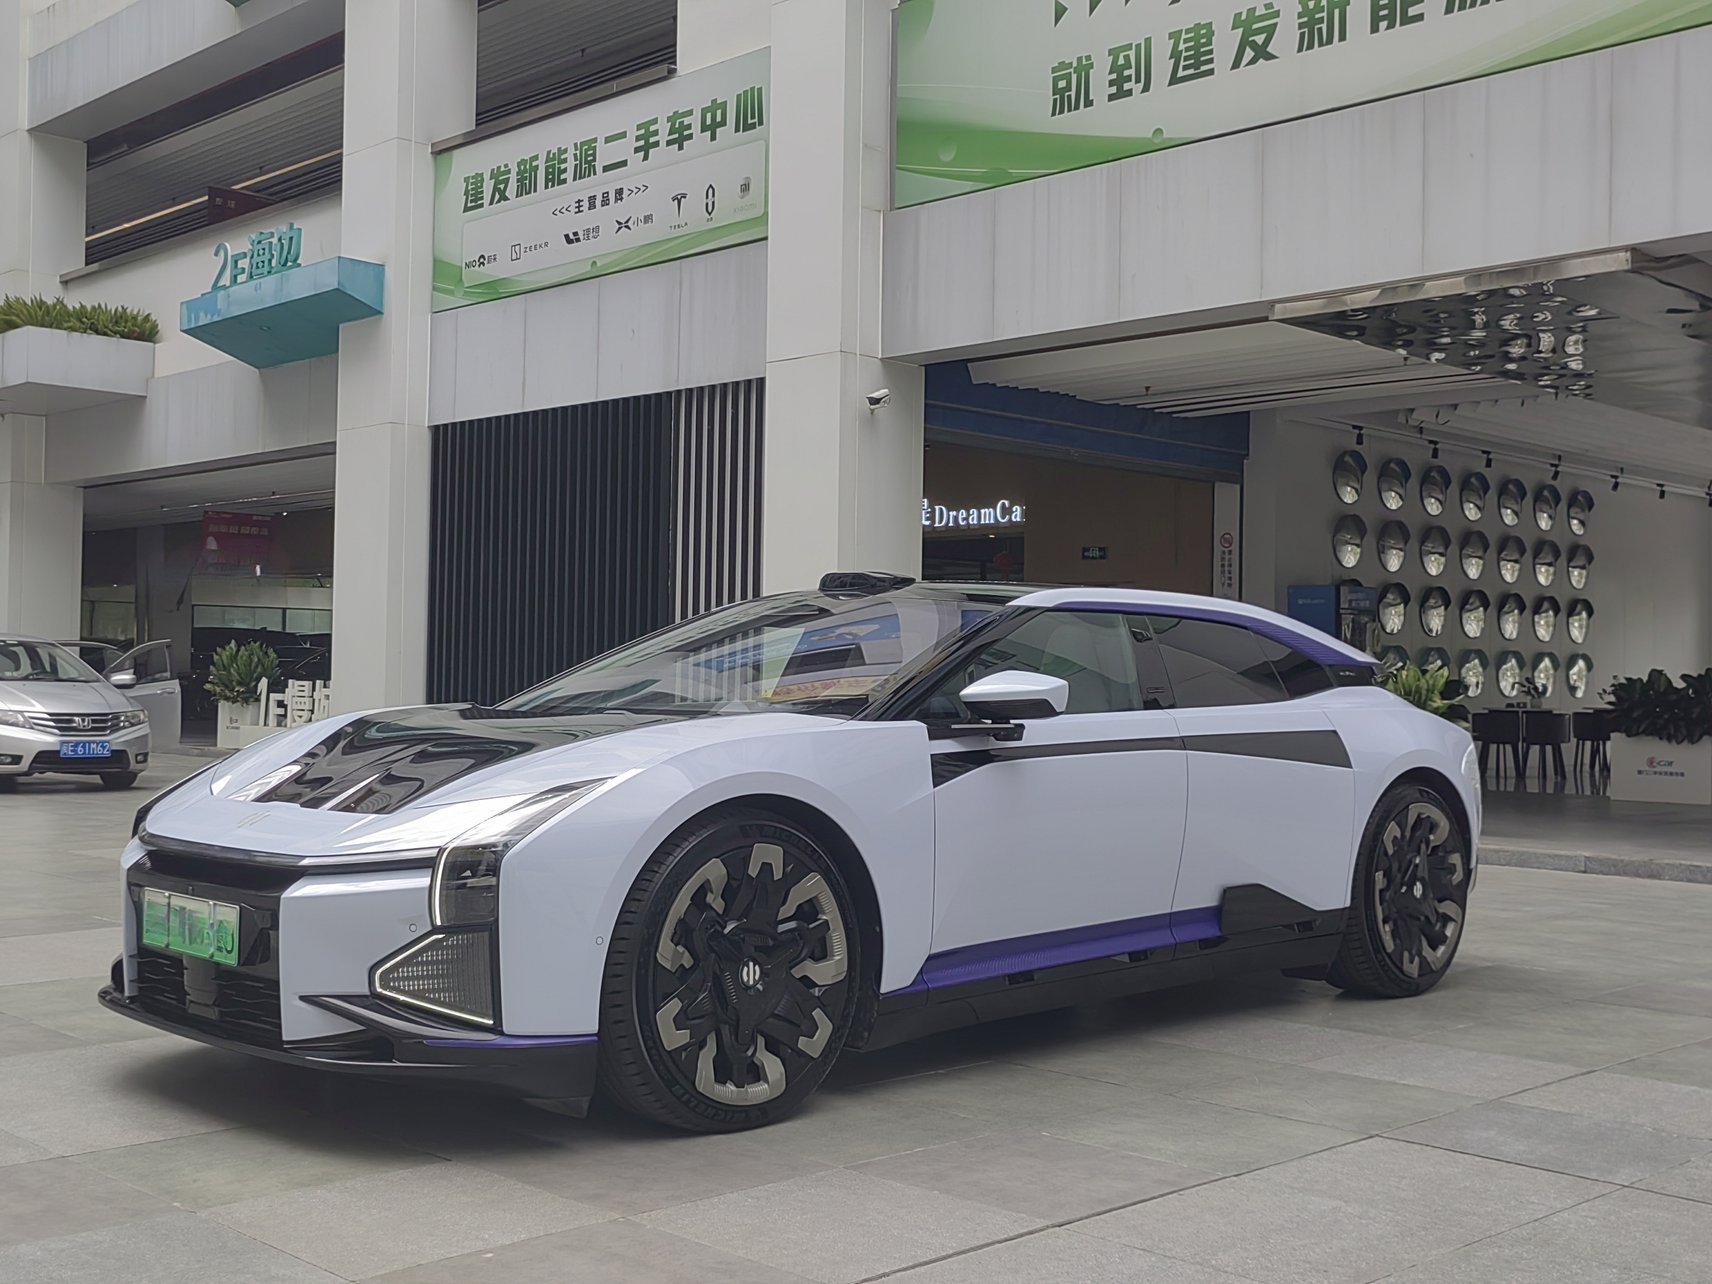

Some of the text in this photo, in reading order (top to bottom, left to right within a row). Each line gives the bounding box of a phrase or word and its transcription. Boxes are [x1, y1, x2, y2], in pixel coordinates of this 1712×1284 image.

[1050, 0, 1504, 118] 就到建发新能
[462, 85, 765, 213] 建发新能源二手车中心
[574, 187, 625, 214] 主营品牌
[633, 213, 654, 227] 小鹏
[669, 223, 688, 231] TESLA
[582, 225, 601, 242] 理想
[523, 241, 549, 253] ZEEKR
[211, 222, 303, 292] 2F海边
[464, 259, 477, 270] NIO
